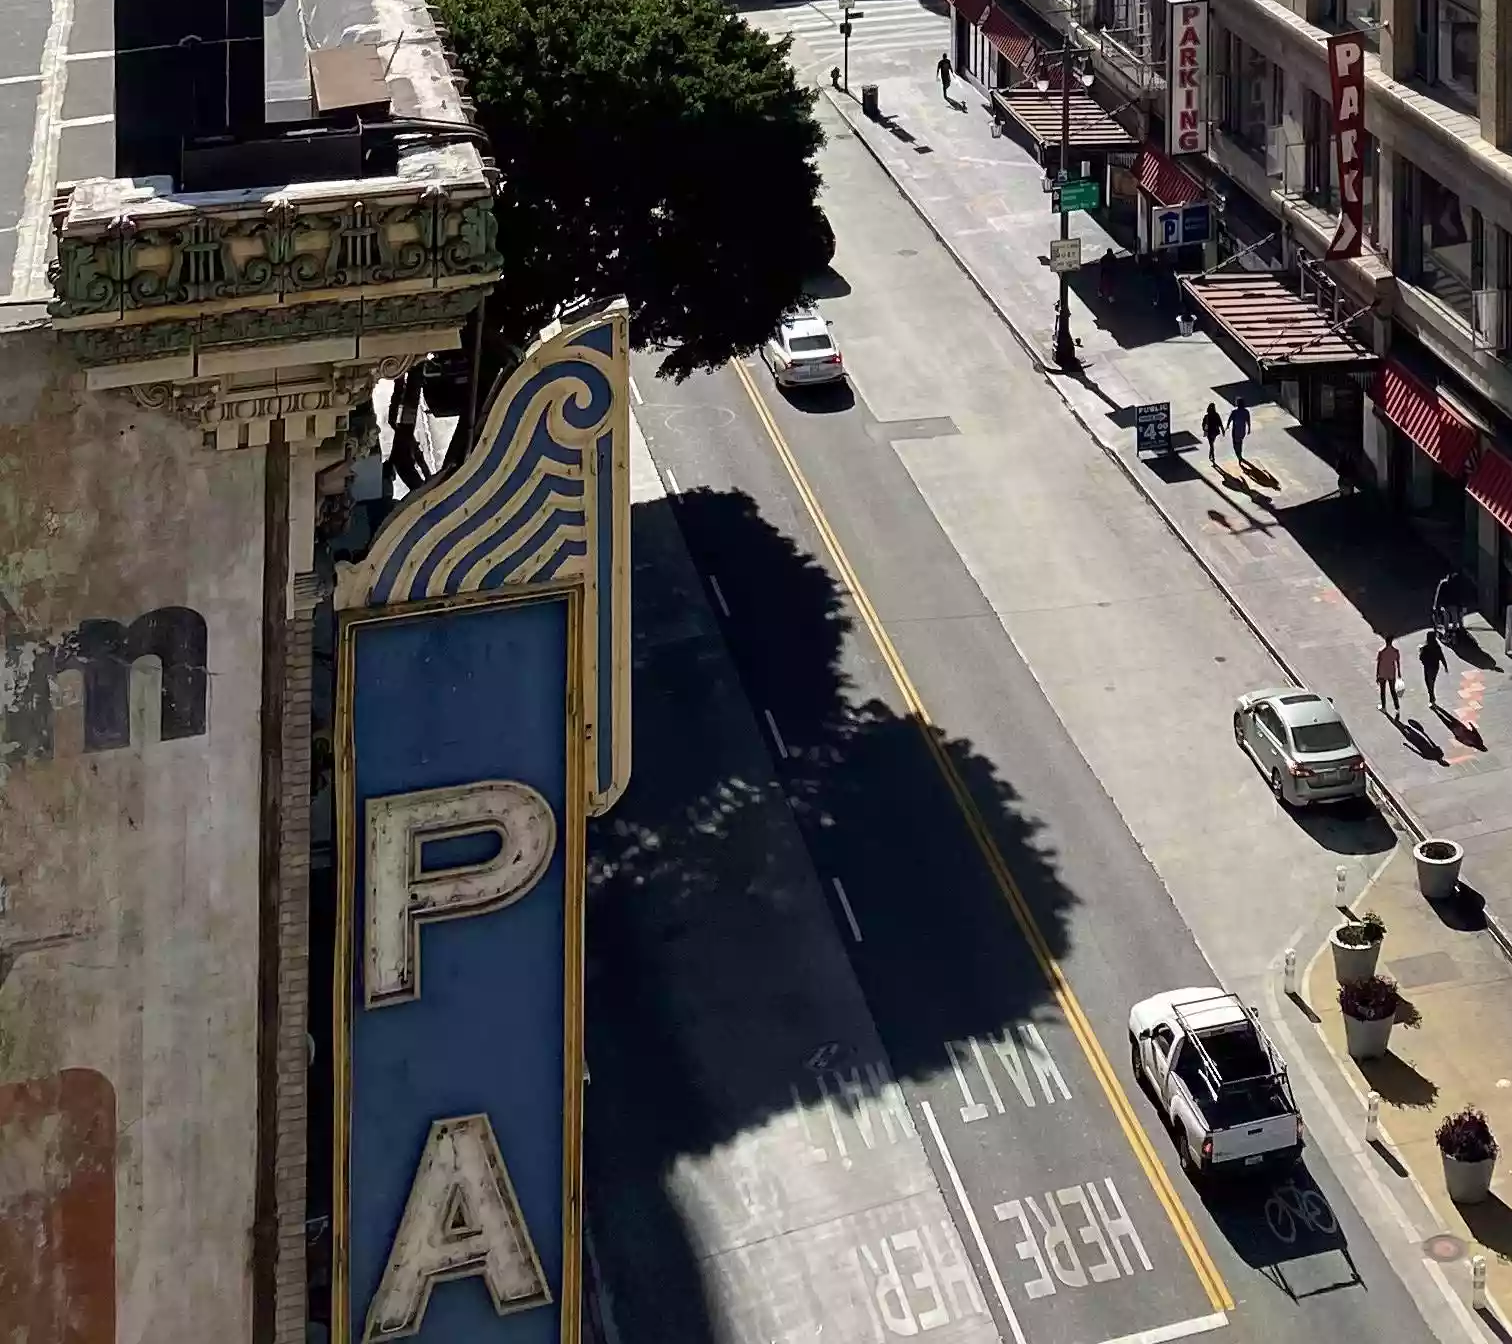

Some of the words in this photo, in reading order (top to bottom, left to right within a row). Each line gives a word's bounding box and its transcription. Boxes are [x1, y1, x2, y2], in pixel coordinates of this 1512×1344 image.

[1179, 6, 1200, 150] PARKING
[1335, 43, 1361, 203] PARK
[943, 1023, 1072, 1123] WAIT
[994, 1177, 1154, 1299] HERE
